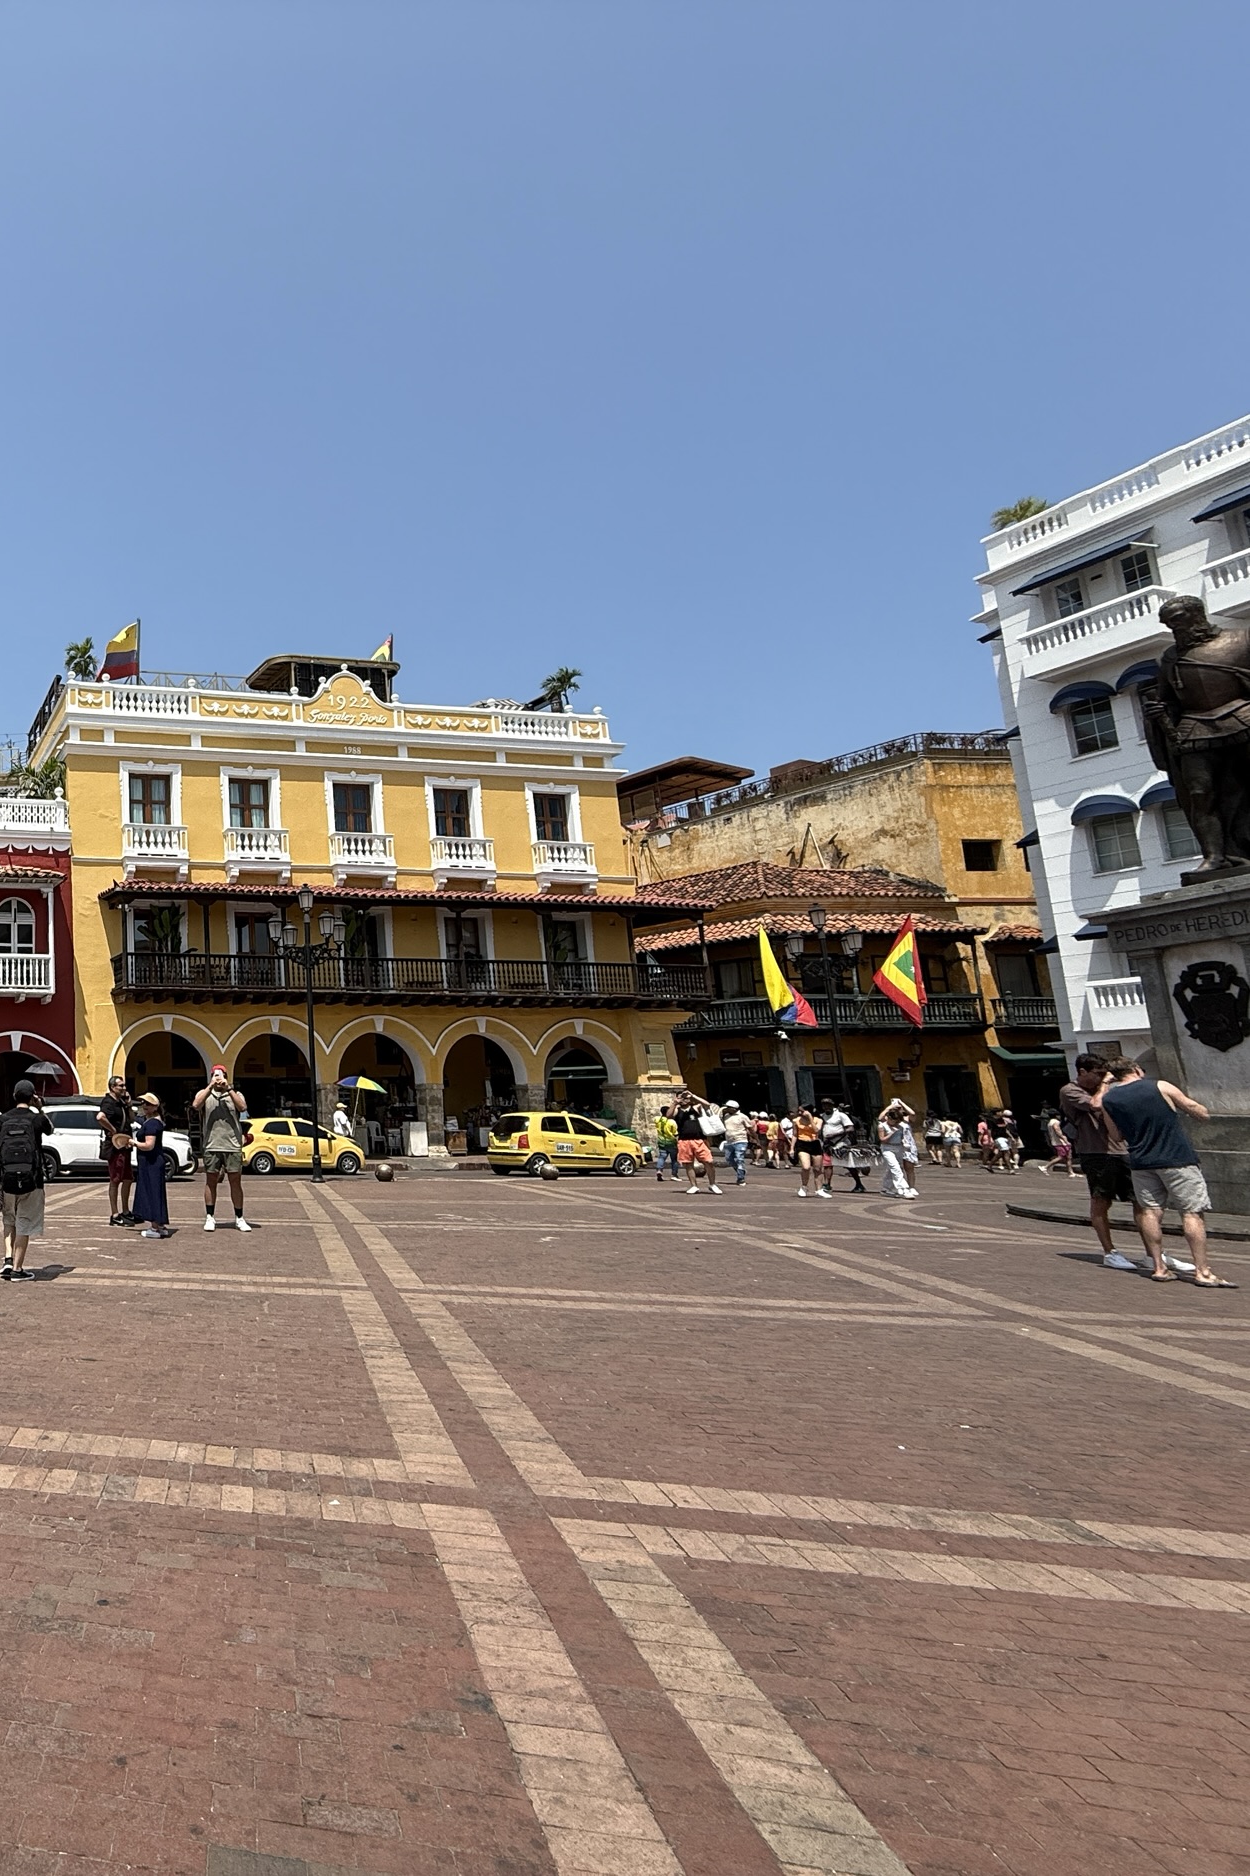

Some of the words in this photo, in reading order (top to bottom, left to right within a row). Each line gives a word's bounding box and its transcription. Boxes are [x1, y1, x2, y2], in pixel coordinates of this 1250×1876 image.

[327, 694, 372, 710] 1922
[343, 746, 362, 755] 1988
[1114, 923, 1168, 943] PEDRO
[1185, 910, 1250, 932] HEREDI
